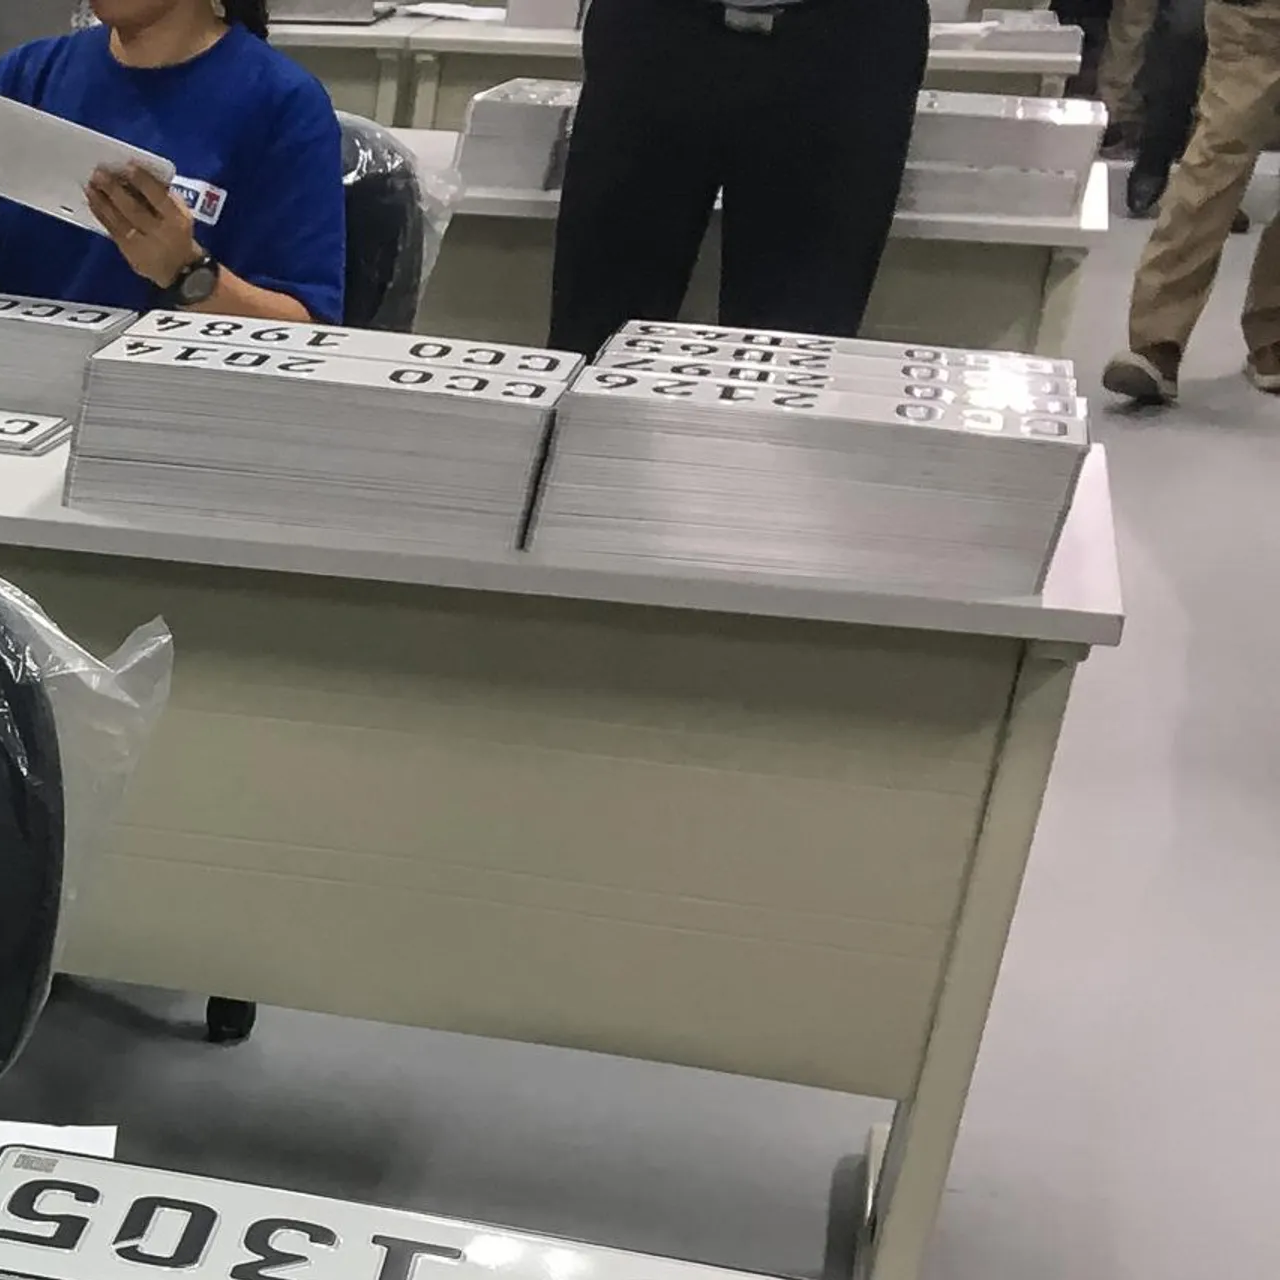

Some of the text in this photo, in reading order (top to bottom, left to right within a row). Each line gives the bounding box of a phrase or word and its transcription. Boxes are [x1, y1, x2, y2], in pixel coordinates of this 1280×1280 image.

[156, 315, 561, 373] CCO 1984
[625, 338, 830, 368] 2065
[125, 339, 546, 399] CCO 2014
[612, 357, 832, 389] 2097
[595, 372, 819, 409] 2126
